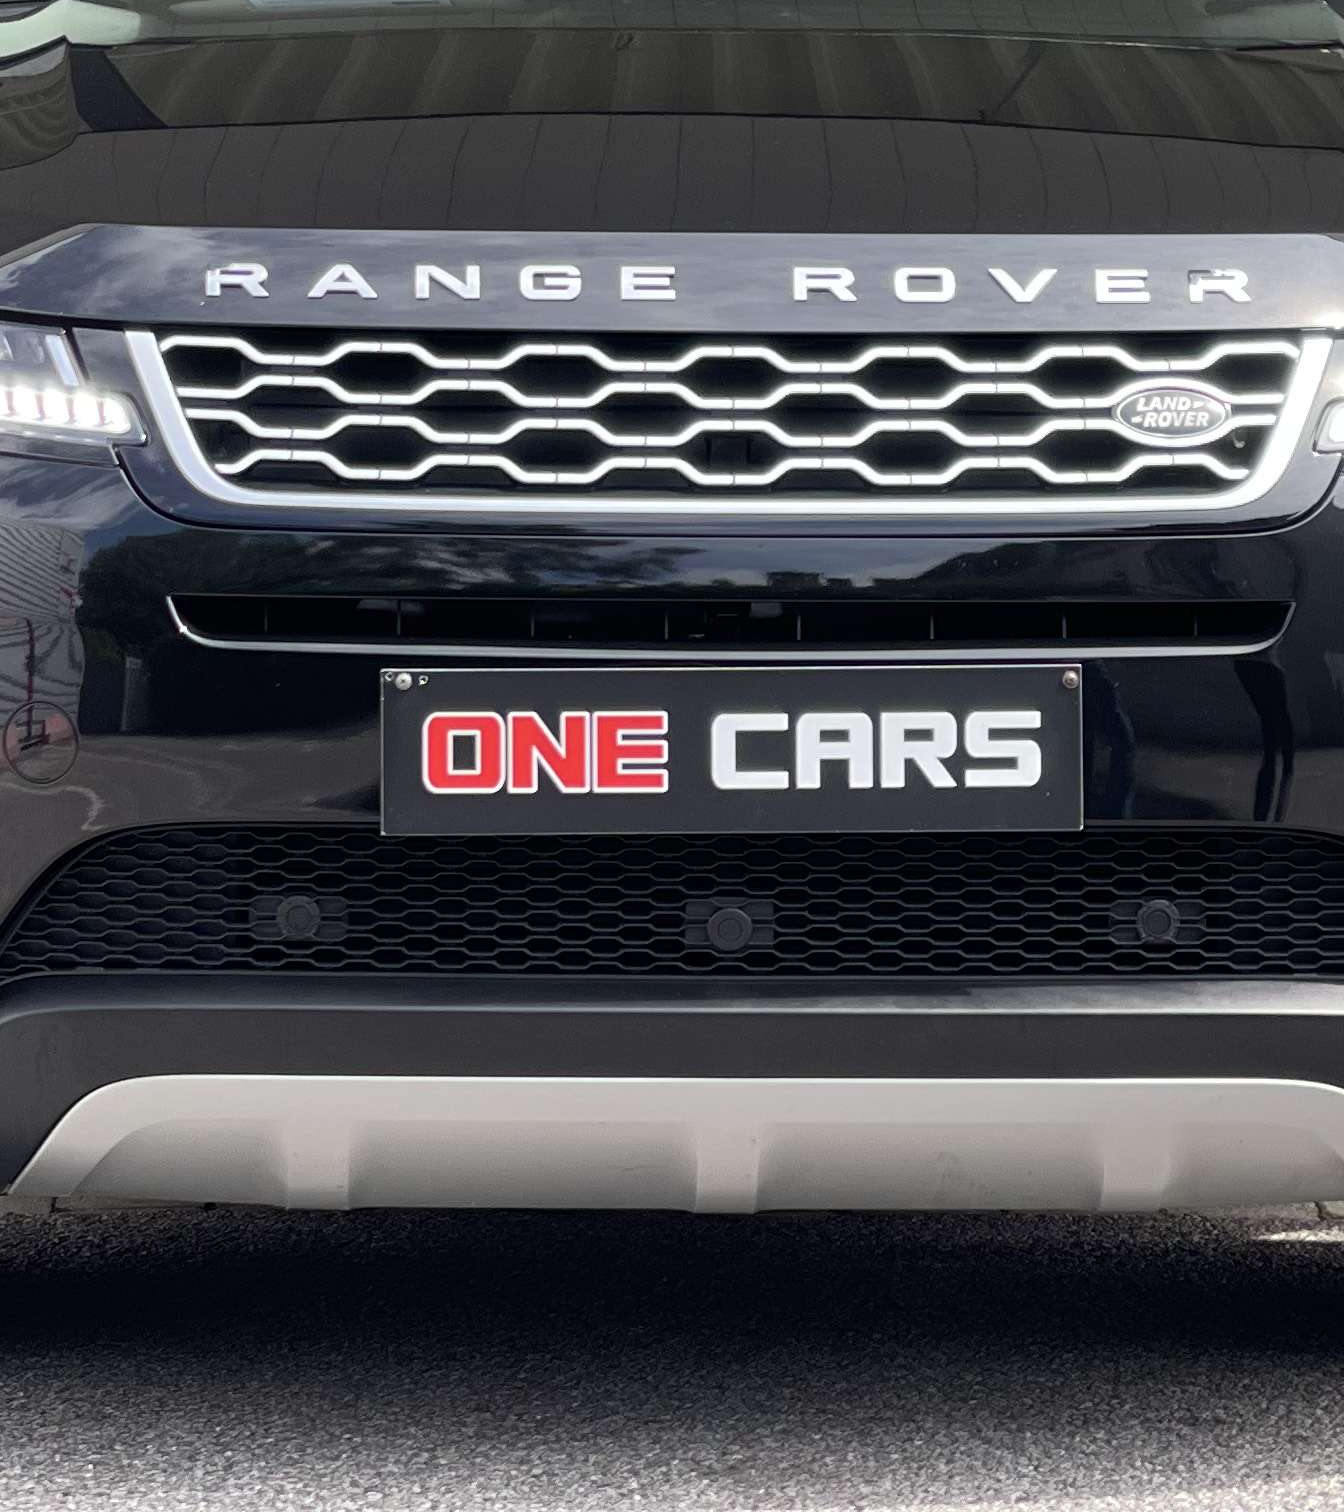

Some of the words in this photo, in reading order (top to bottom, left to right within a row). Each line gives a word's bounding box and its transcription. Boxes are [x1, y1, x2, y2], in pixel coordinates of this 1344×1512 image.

[204, 262, 677, 301] RANGE
[792, 265, 1252, 304] ROVER
[1136, 396, 1192, 411] LAND
[1143, 412, 1210, 427] ROVER
[422, 710, 670, 795] ONE
[710, 711, 1042, 790] CARS
